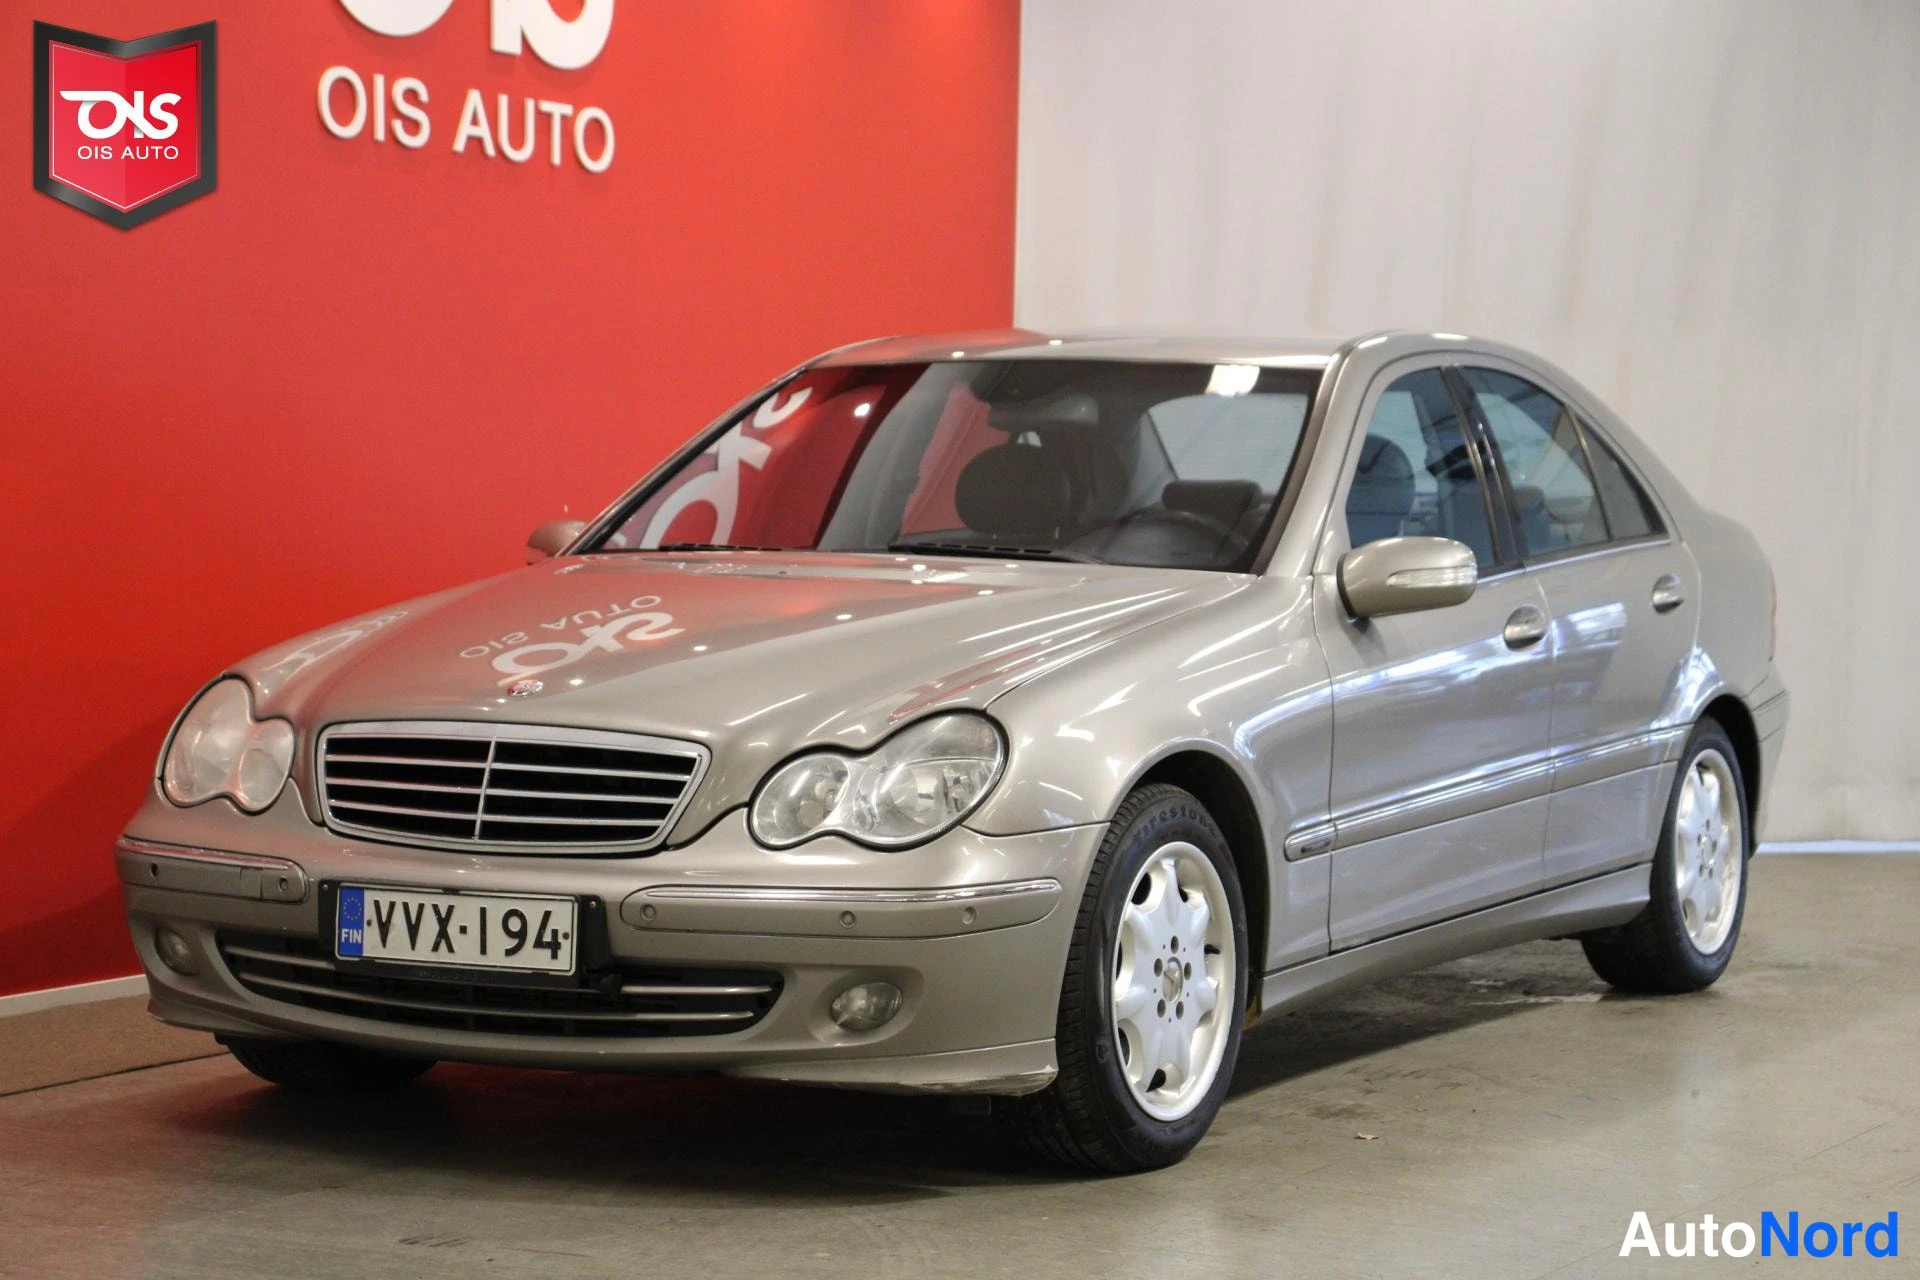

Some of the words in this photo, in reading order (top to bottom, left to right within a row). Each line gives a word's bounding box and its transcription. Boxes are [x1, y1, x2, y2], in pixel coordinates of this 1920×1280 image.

[318, 66, 430, 148] OIS
[453, 89, 615, 173] AUTO
[341, 928, 362, 944] FIN
[374, 900, 562, 960] VVX-194
